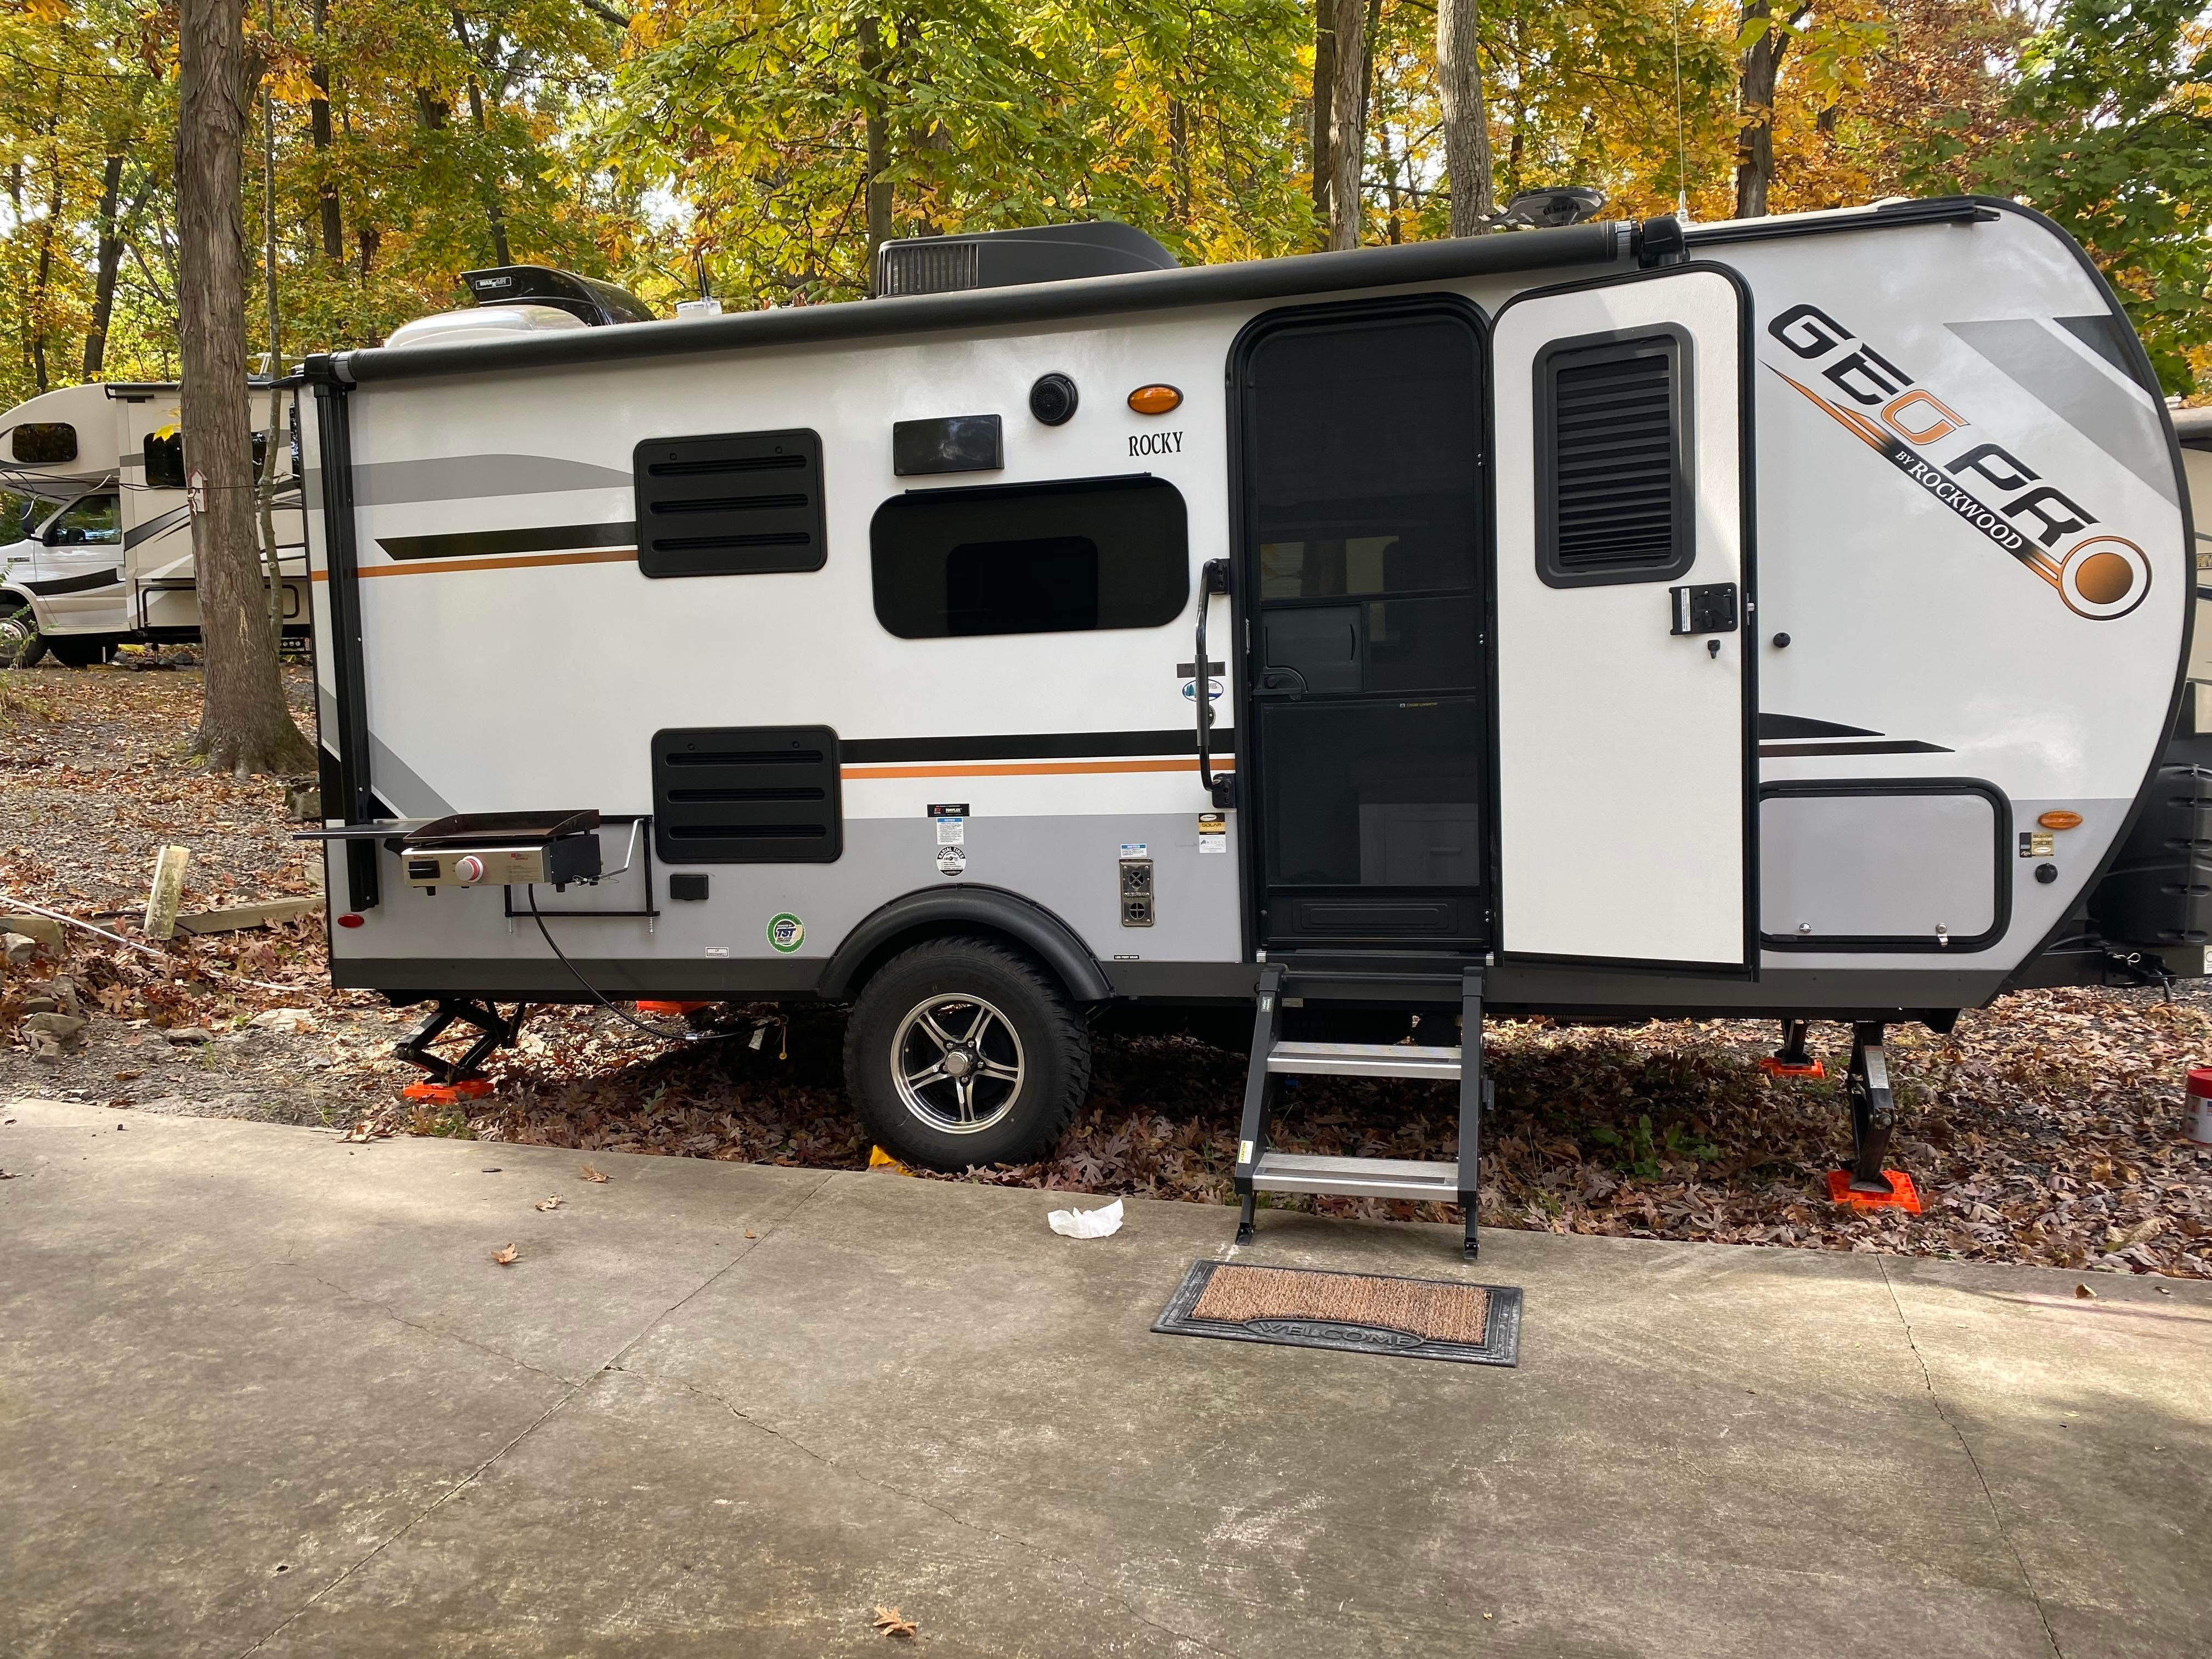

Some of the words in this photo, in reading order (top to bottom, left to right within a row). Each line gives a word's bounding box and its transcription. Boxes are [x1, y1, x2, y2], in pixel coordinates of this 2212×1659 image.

[1768, 303, 1971, 445] GEO
[1128, 431, 1183, 456] ROCKY
[1895, 450, 1915, 465] BY
[1908, 461, 2023, 549] ROCKWOOD
[938, 847, 952, 859] RADIAL
[953, 847, 964, 859] TIRES
[777, 928, 797, 937] TST
[1259, 1322, 1412, 1345] WELCOME
